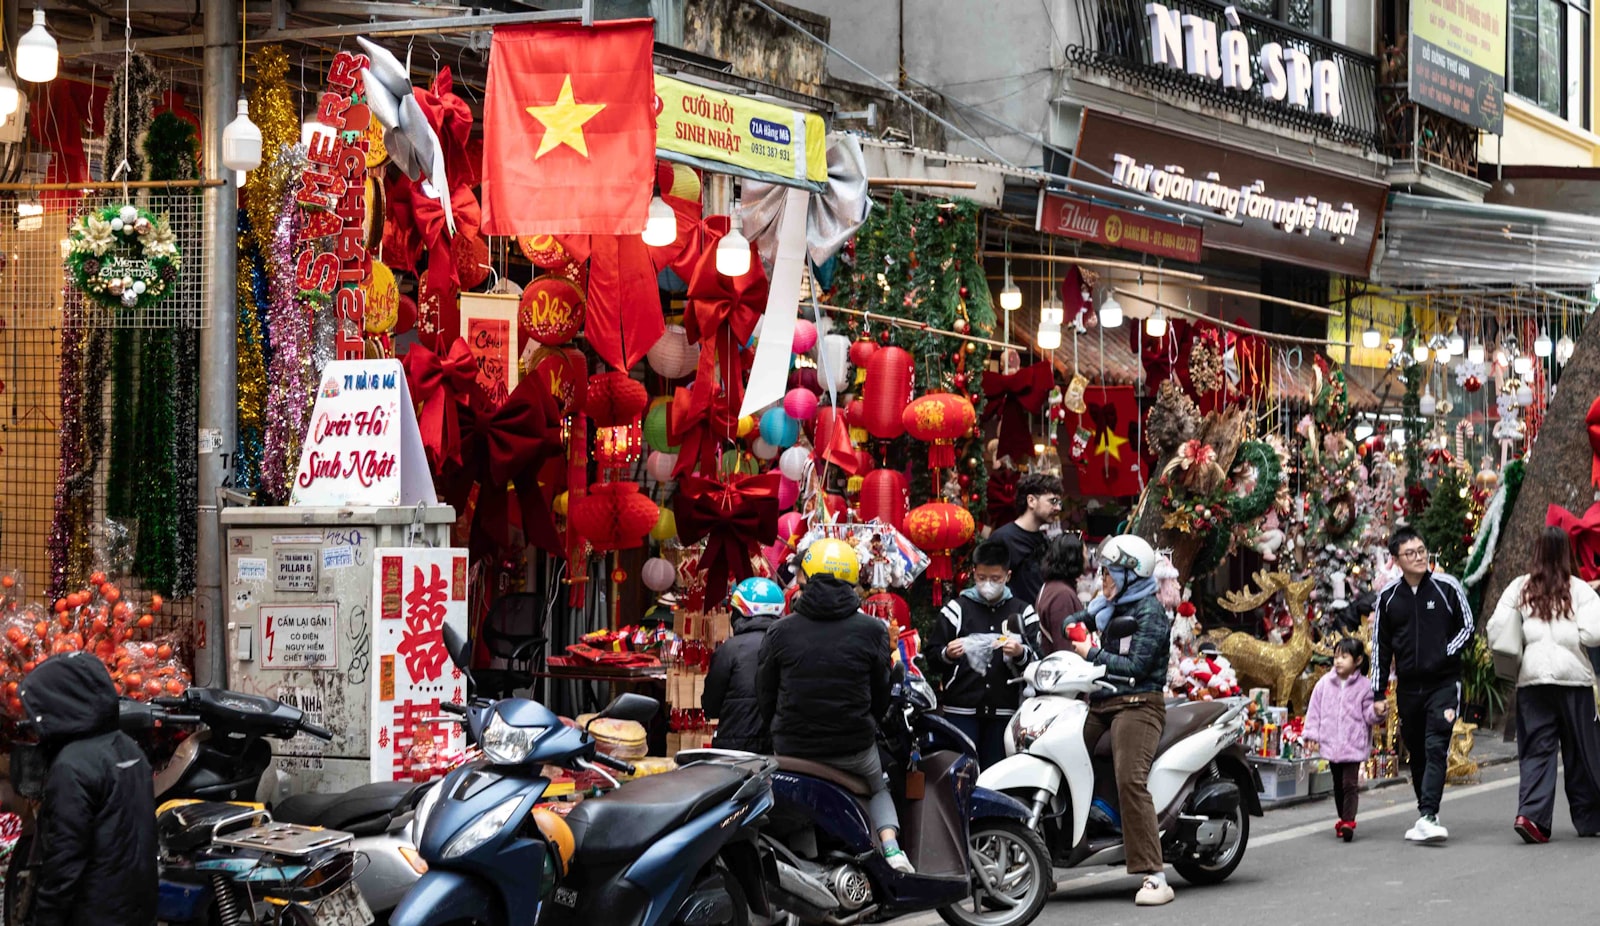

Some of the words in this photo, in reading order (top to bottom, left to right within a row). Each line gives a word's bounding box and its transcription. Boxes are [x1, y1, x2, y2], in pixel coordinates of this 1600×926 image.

[1146, 4, 1253, 91] NHÀ
[1260, 42, 1342, 117] SPA
[682, 93, 711, 119] CƯỚI
[713, 98, 734, 125] HỎI
[751, 121, 763, 135] 71A
[675, 121, 706, 145] SINH
[708, 127, 742, 156] NHẬT
[767, 146, 778, 158] 387
[1112, 153, 1154, 192] Thư
[1193, 171, 1240, 220] nâng
[1275, 195, 1317, 237] nghệ
[1316, 201, 1359, 246] thuật
[113, 256, 148, 270] Merry
[100, 267, 158, 279] Christmas
[314, 412, 353, 444] Cưới
[354, 405, 391, 436] Hỏi
[299, 450, 341, 488] Sinh
[343, 449, 395, 488] Nhật
[280, 563, 305, 573] PILLAR
[277, 614, 294, 627] CẤM
[296, 617, 309, 629] LẠI
[302, 631, 319, 641] ĐIỆN
[285, 643, 305, 651] NGUY
[283, 652, 302, 662] CHẾT
